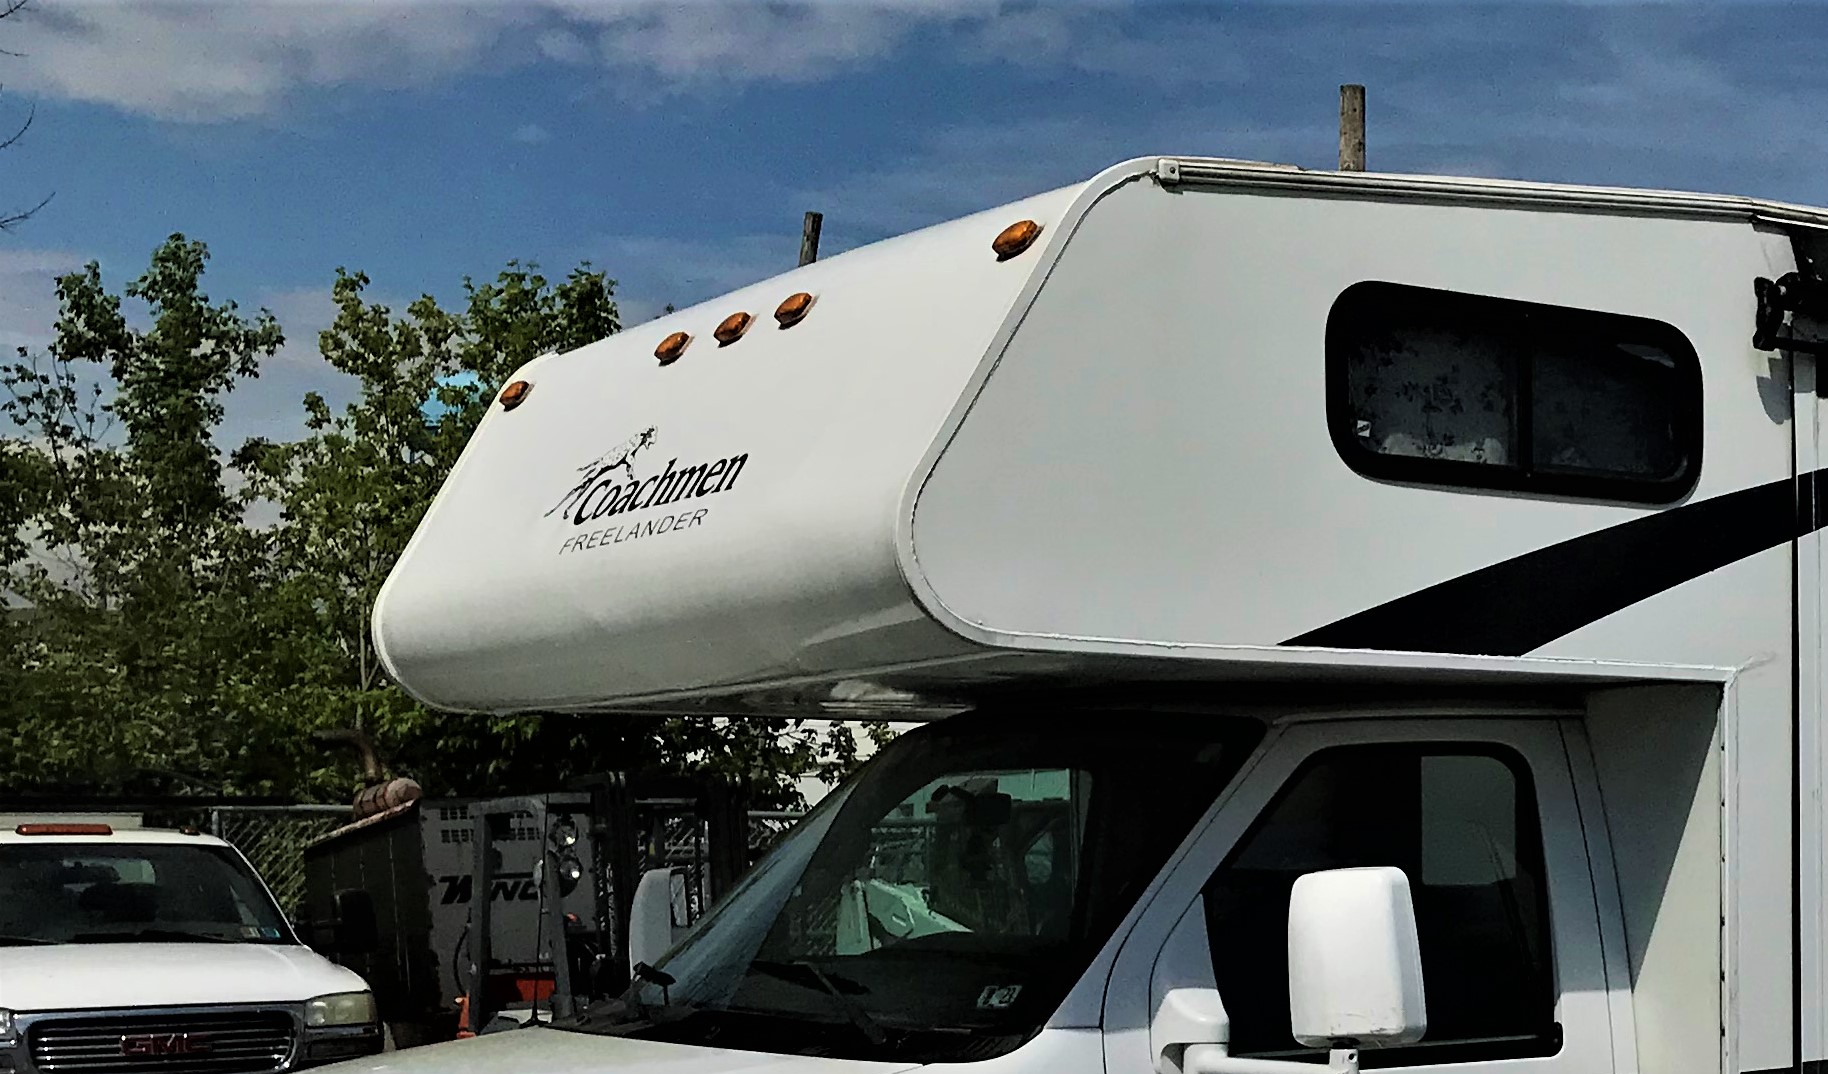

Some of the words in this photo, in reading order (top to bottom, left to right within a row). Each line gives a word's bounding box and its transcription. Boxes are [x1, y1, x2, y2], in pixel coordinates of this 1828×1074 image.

[573, 452, 749, 526] Coachmen
[558, 508, 709, 556] FREELANDER
[120, 1033, 213, 1056] GMC
